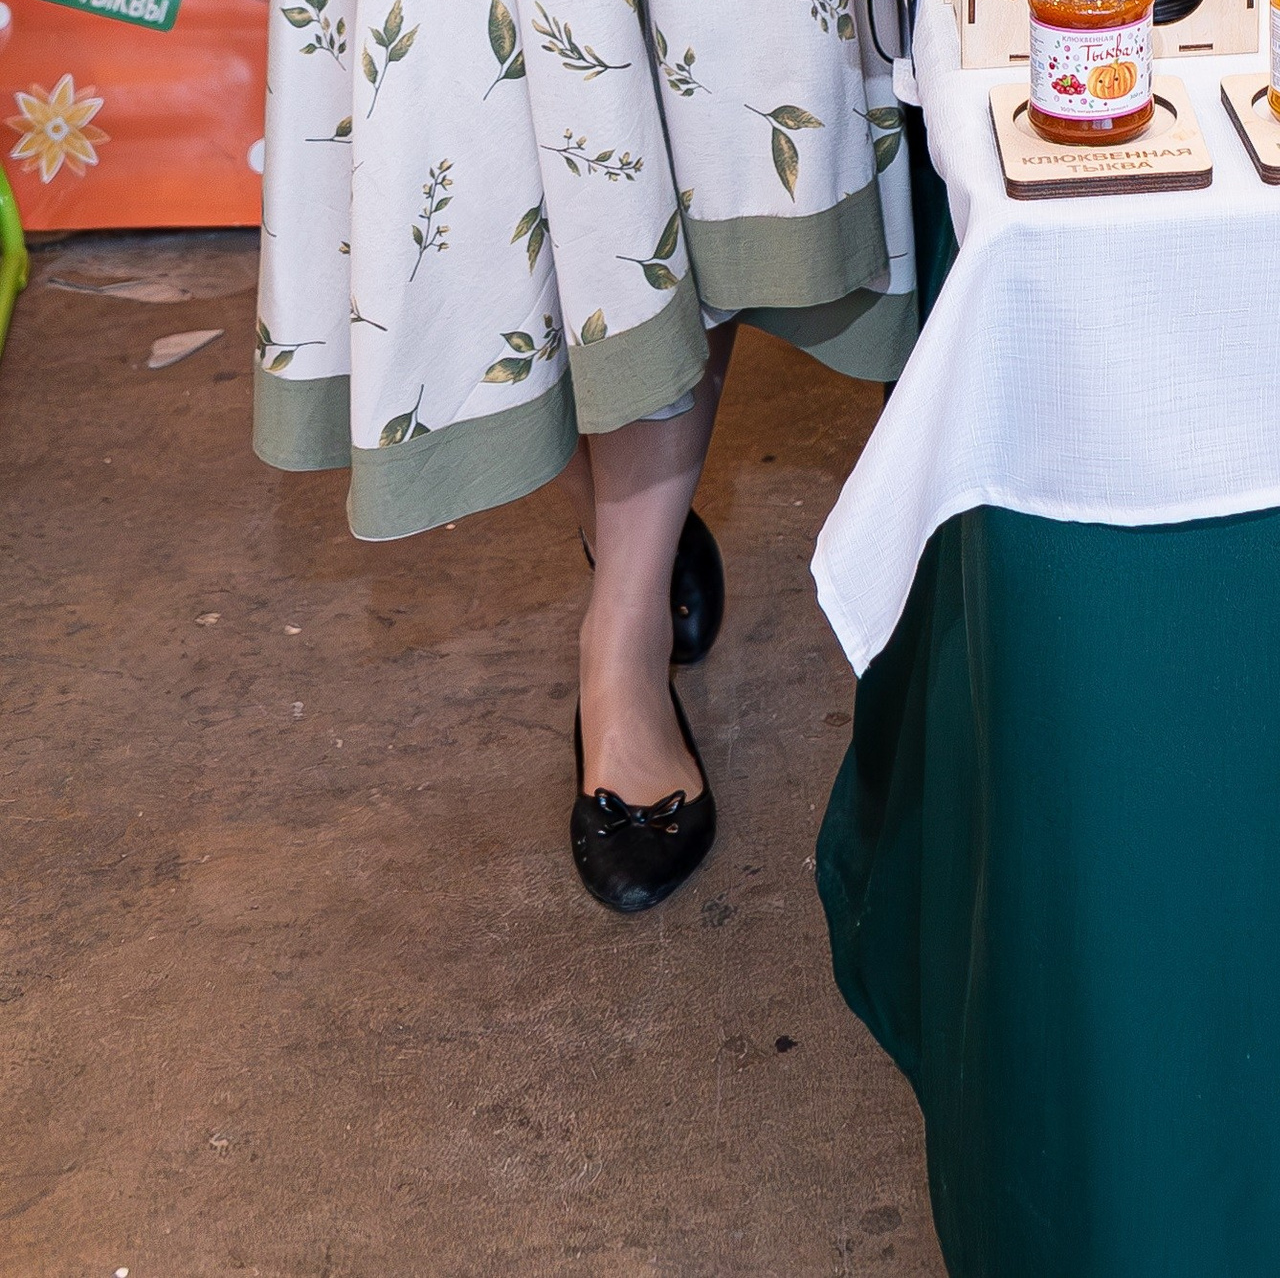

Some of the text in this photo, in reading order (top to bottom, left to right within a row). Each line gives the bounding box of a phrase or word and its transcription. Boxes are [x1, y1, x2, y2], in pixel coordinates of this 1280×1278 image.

[1062, 35, 1114, 43] КЛЮКВЕННАЯ
[1080, 33, 1133, 62] Тыква
[1021, 147, 1192, 166] КЛЮКВЕННАЯ
[1067, 160, 1153, 173] ТЫКВА
